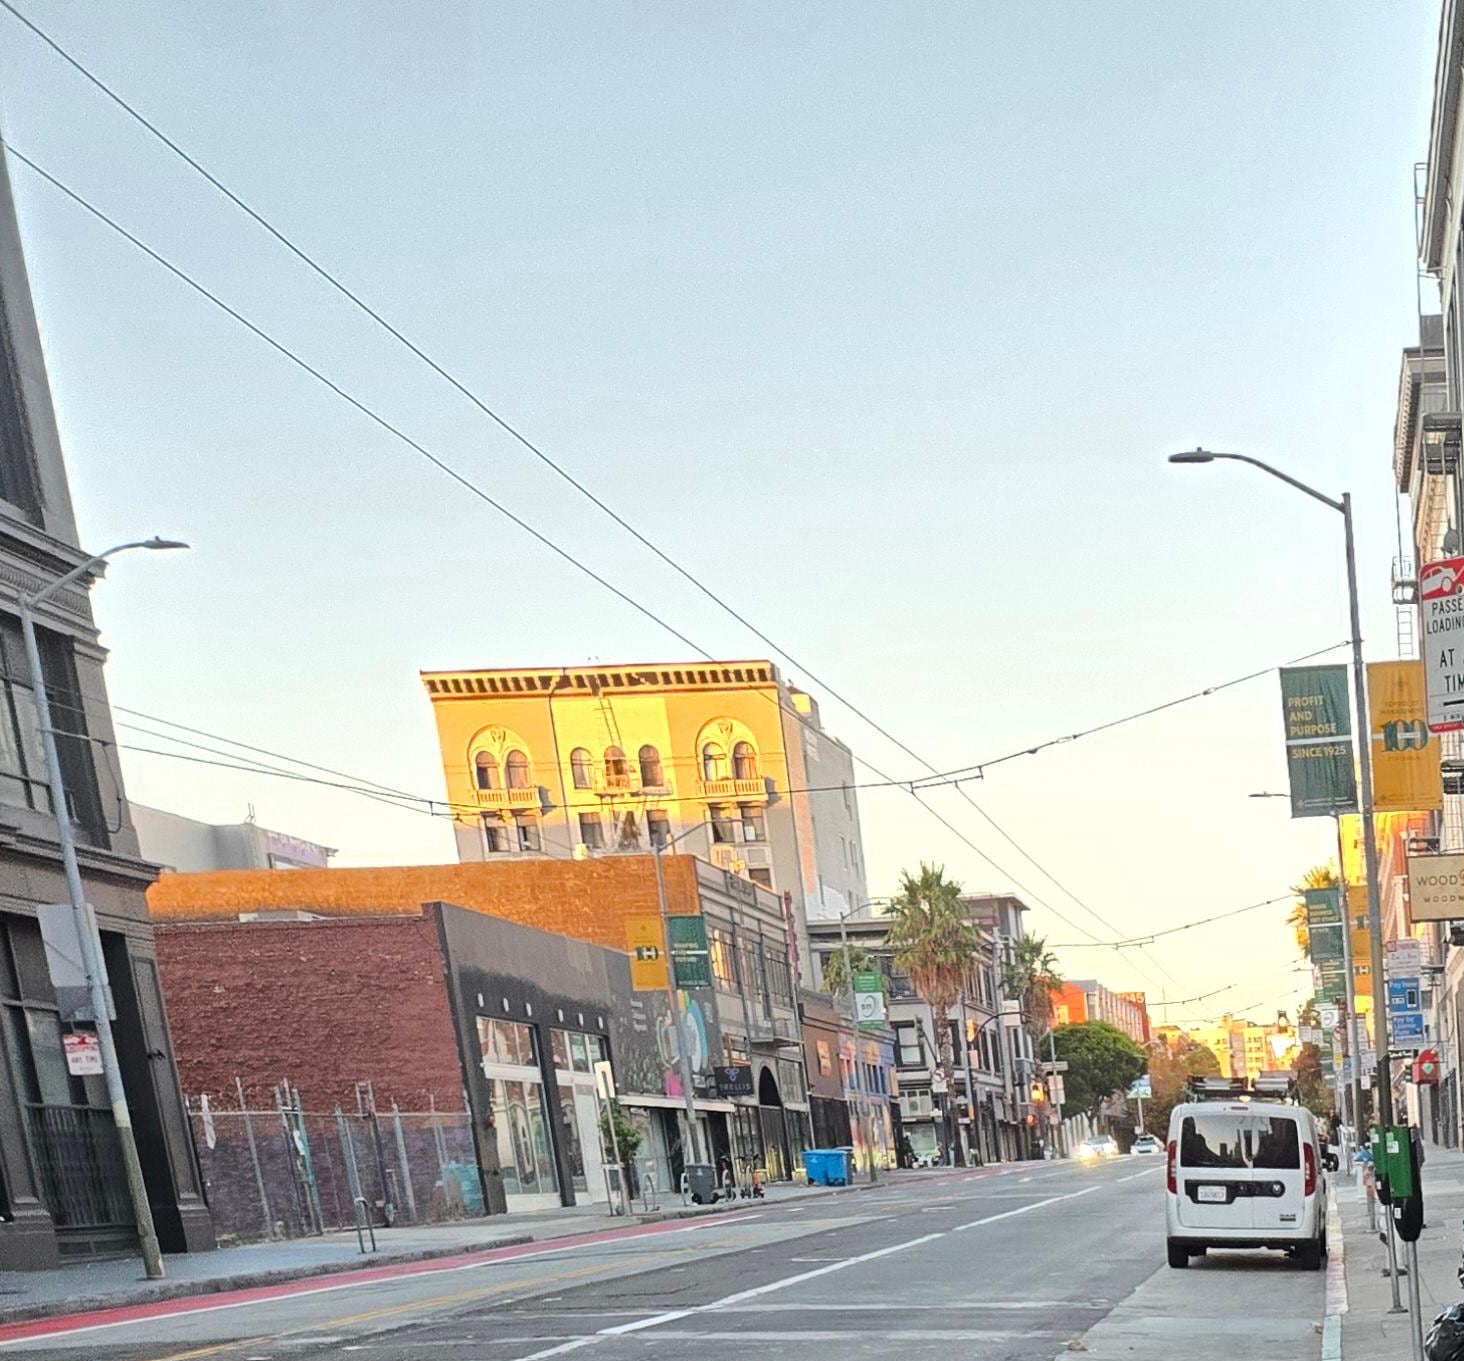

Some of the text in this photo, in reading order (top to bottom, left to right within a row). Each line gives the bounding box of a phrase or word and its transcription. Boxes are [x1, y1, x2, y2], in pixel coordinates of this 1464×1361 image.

[1440, 648, 1455, 668] AT
[1288, 695, 1324, 708] PROFIT
[1290, 711, 1312, 722] AND
[1290, 722, 1337, 737] PURPOSE
[1292, 744, 1346, 759] SINCE 1925
[1416, 874, 1458, 887] WOOD
